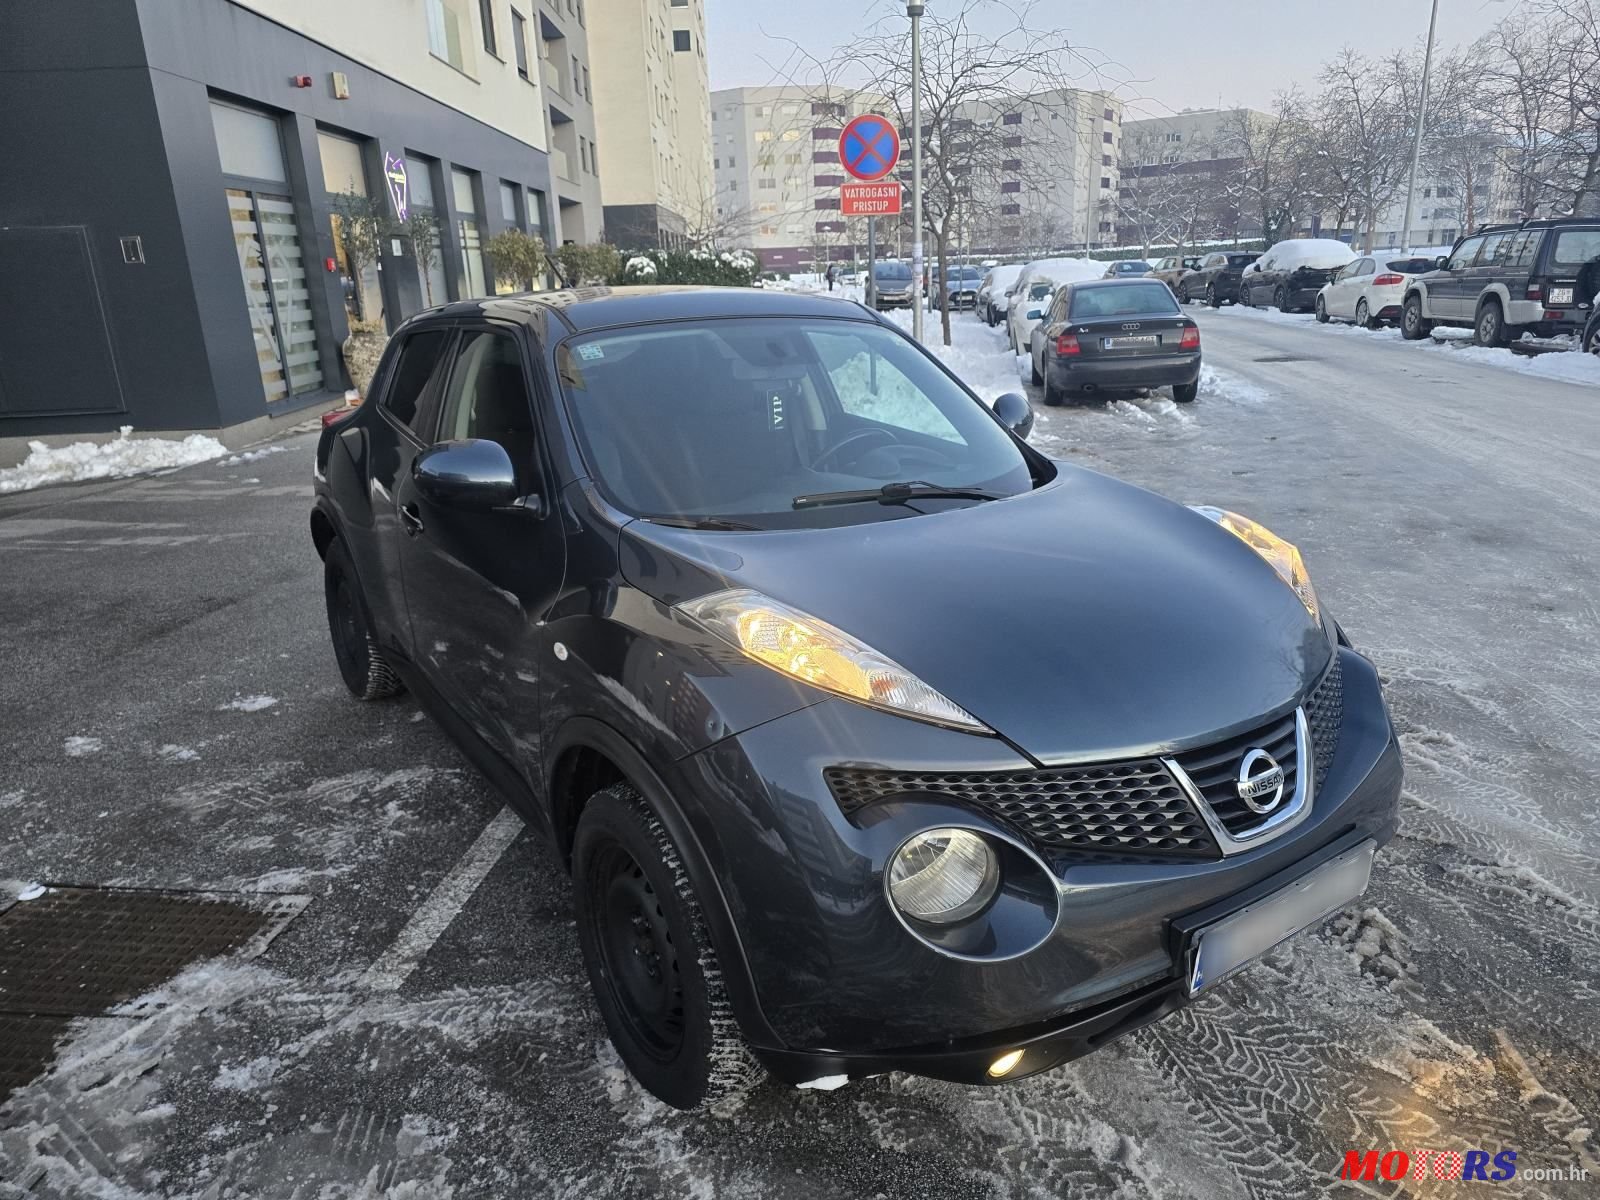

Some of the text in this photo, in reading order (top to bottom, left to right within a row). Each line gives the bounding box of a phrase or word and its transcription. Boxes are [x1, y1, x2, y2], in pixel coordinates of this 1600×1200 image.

[844, 187, 897, 199] VATROGASNI
[853, 200, 889, 212] PRISTUP
[773, 396, 783, 425] VIP
[1247, 773, 1283, 794] NISSAN
